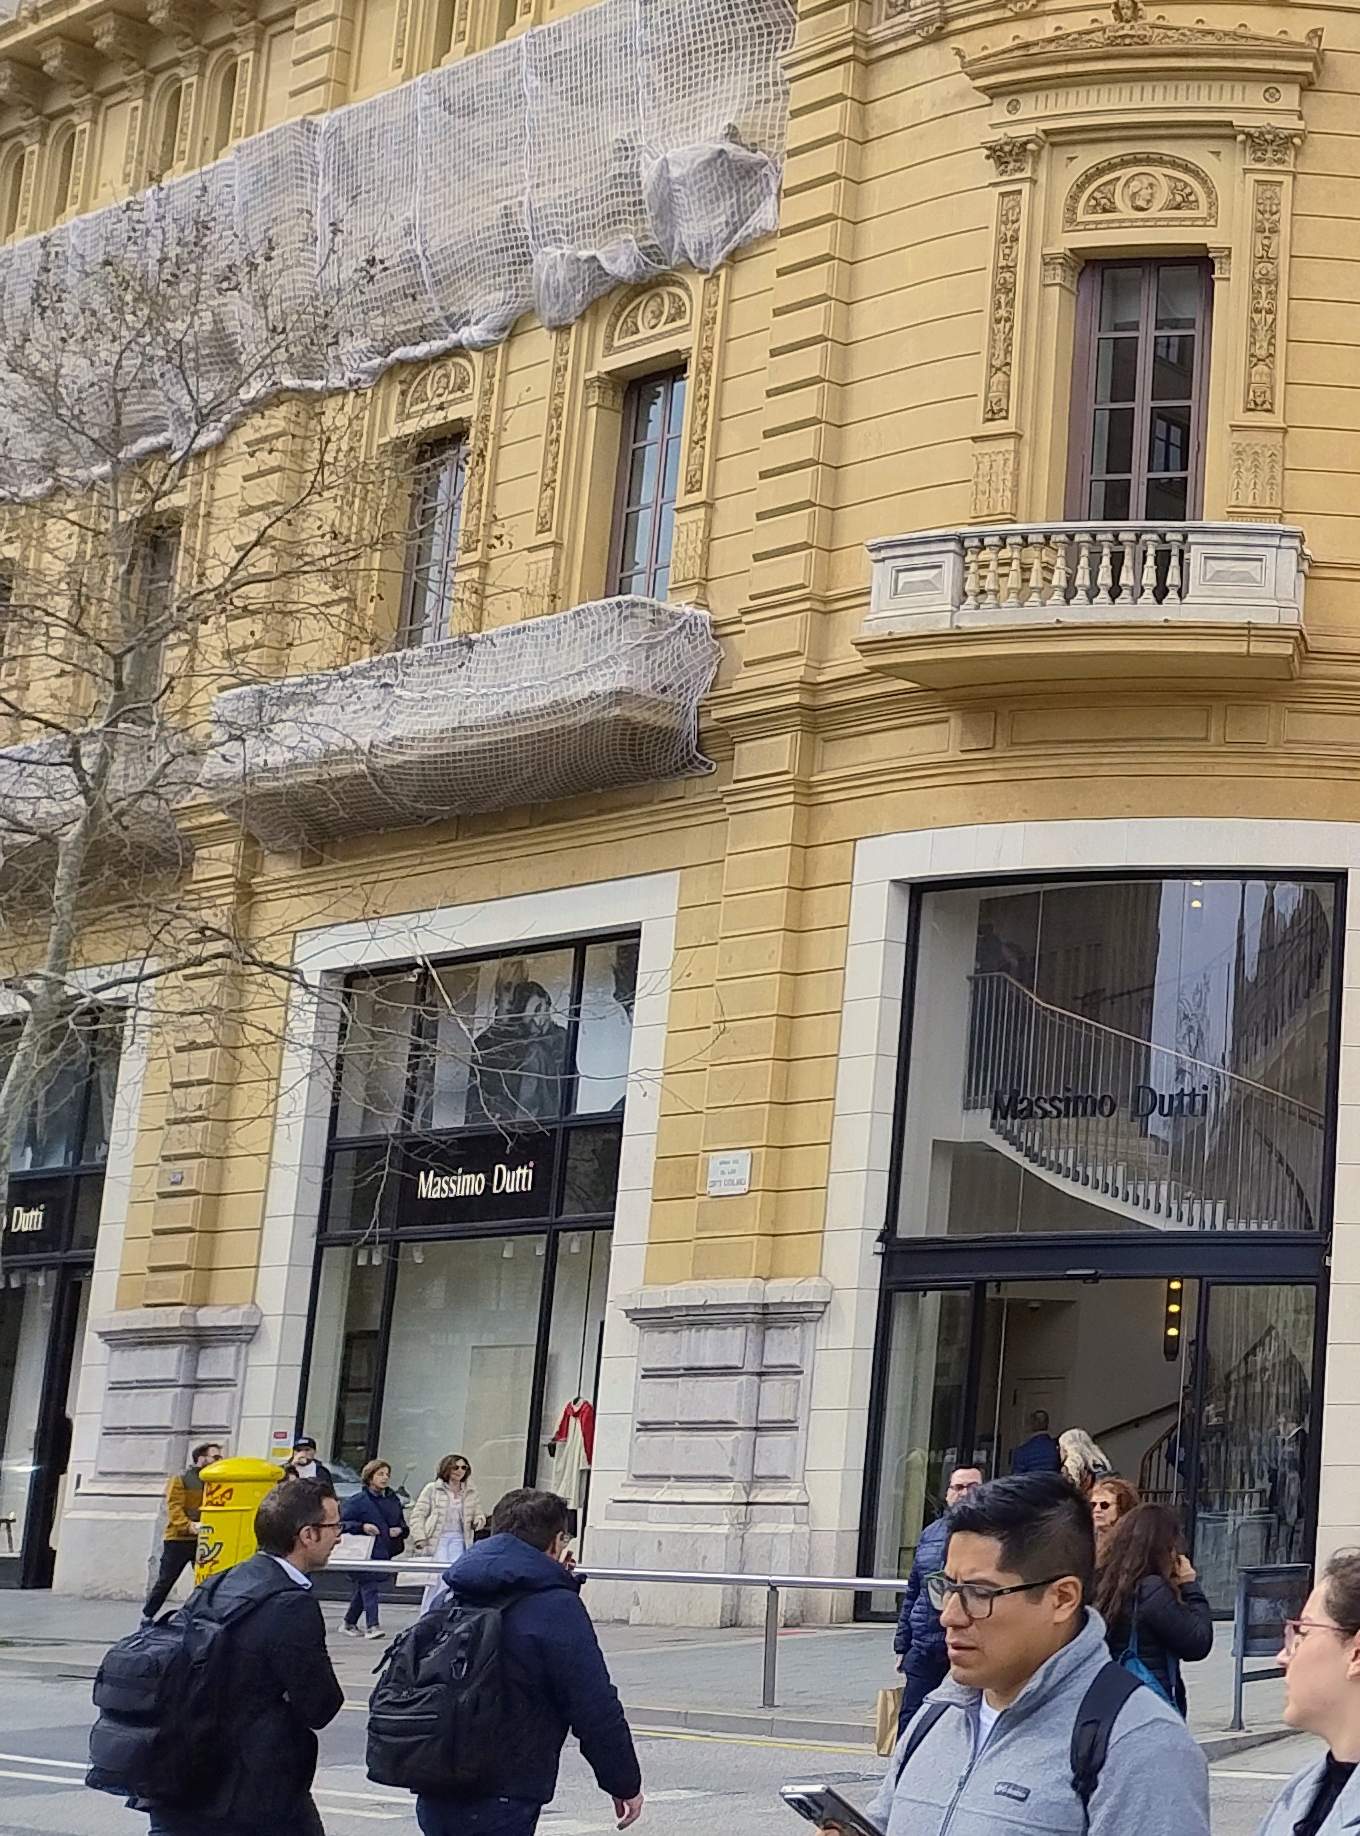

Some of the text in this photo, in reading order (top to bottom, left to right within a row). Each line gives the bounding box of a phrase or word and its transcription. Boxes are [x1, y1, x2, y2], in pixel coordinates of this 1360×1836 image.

[990, 1084, 1209, 1121] Massimo Dutti
[417, 1160, 535, 1199] Massimo Dutti
[11, 1203, 46, 1233] Dutti
